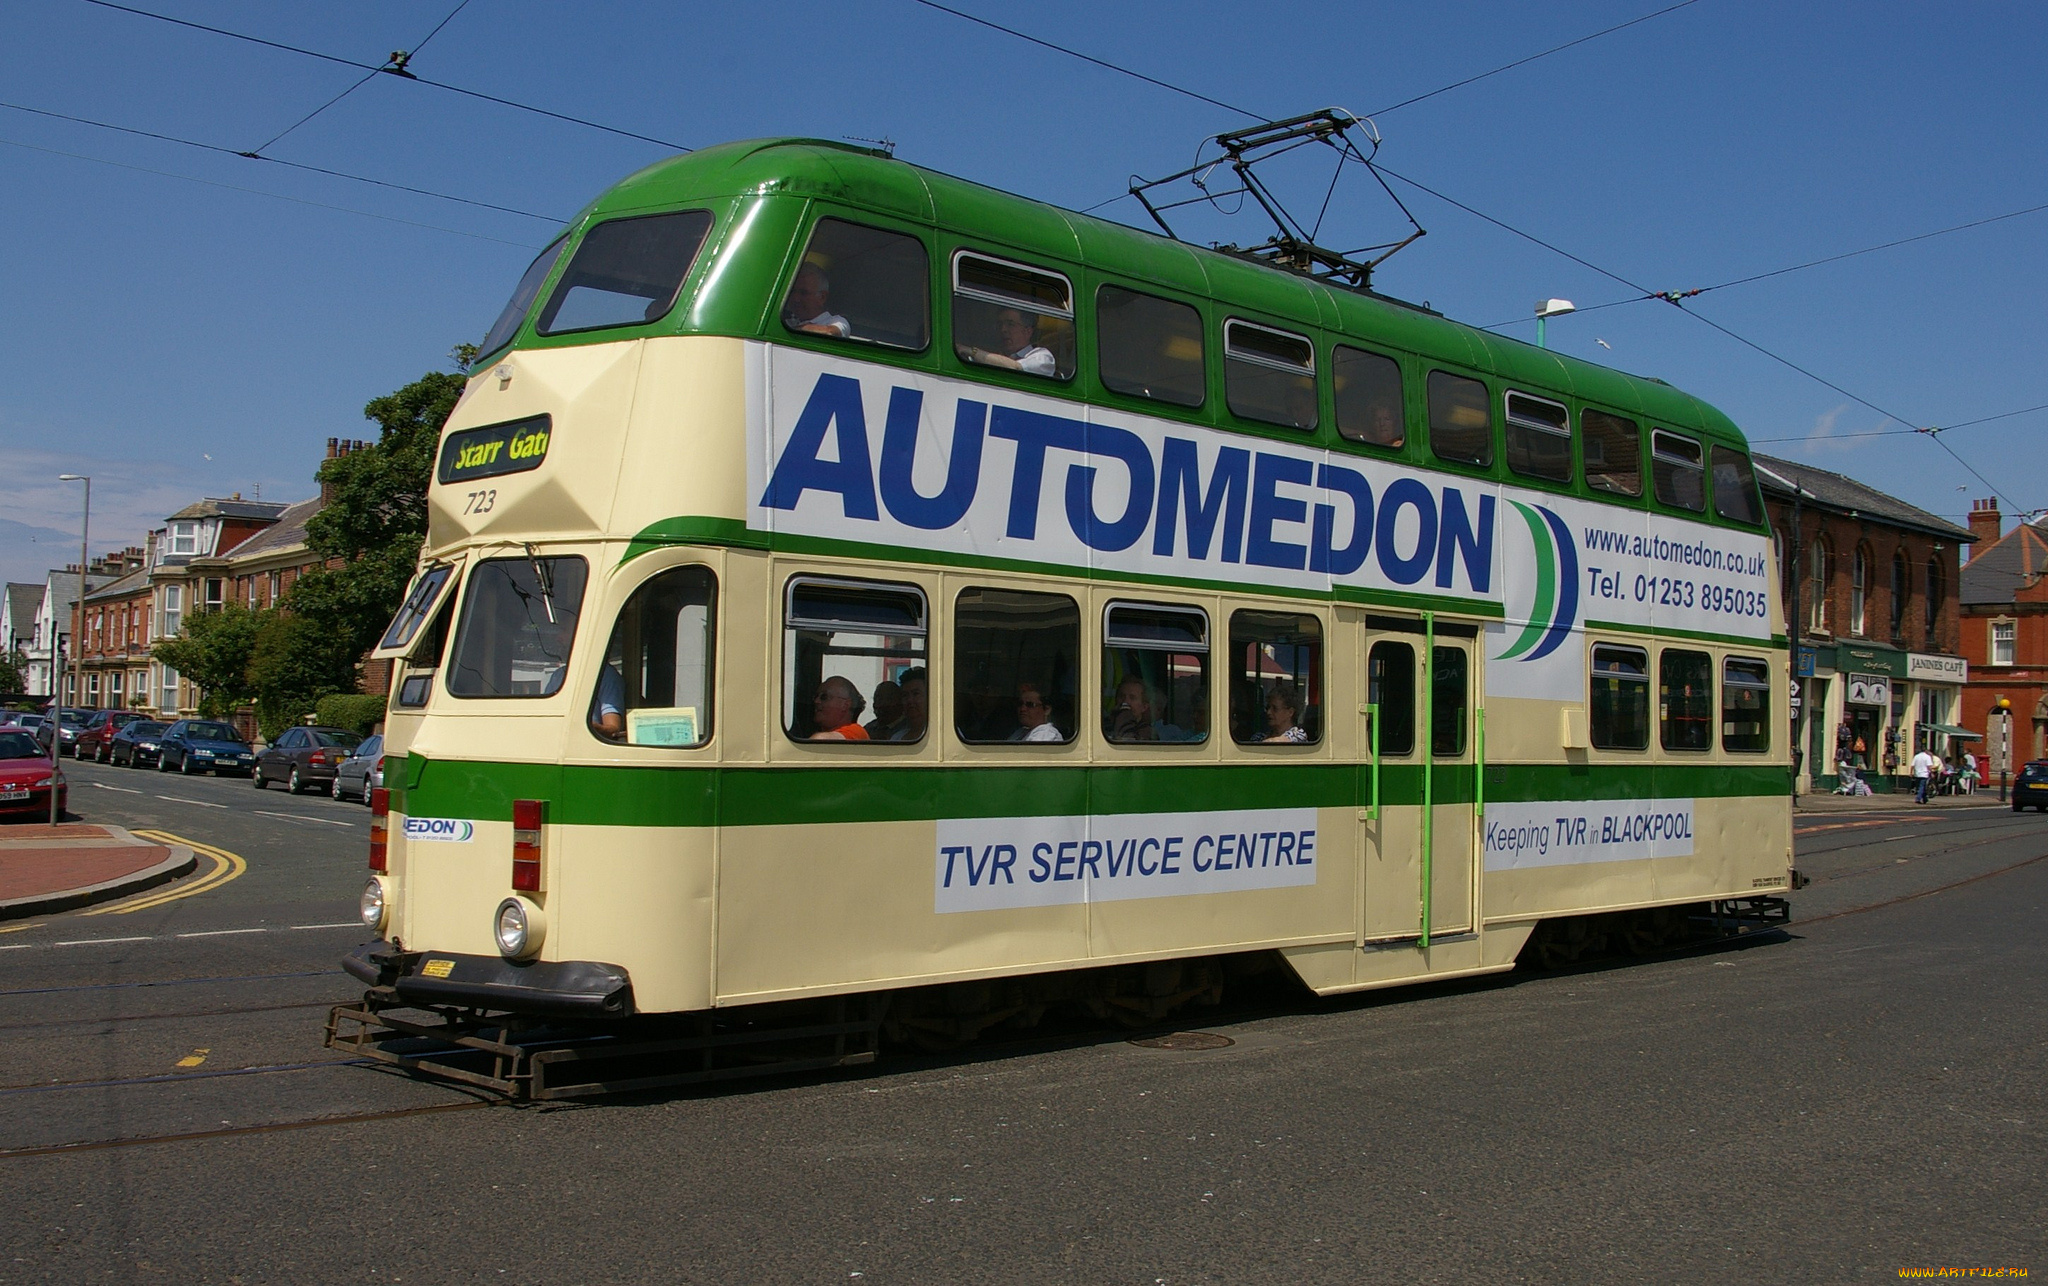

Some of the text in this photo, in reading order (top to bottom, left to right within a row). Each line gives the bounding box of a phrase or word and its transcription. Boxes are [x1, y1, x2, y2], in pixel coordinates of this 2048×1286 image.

[455, 438, 505, 470] Starr
[463, 489, 497, 516] 723
[759, 372, 1496, 594] AUTOMEDON
[1584, 527, 1766, 578] www.automedon.co.uk
[1587, 567, 1767, 619] Tel. 01253 895035
[1486, 766, 1507, 784] 723
[1485, 812, 1692, 857] Keeping TVR in BLACKPOOL
[939, 830, 1316, 889] TVR SERVICE CENTRE
